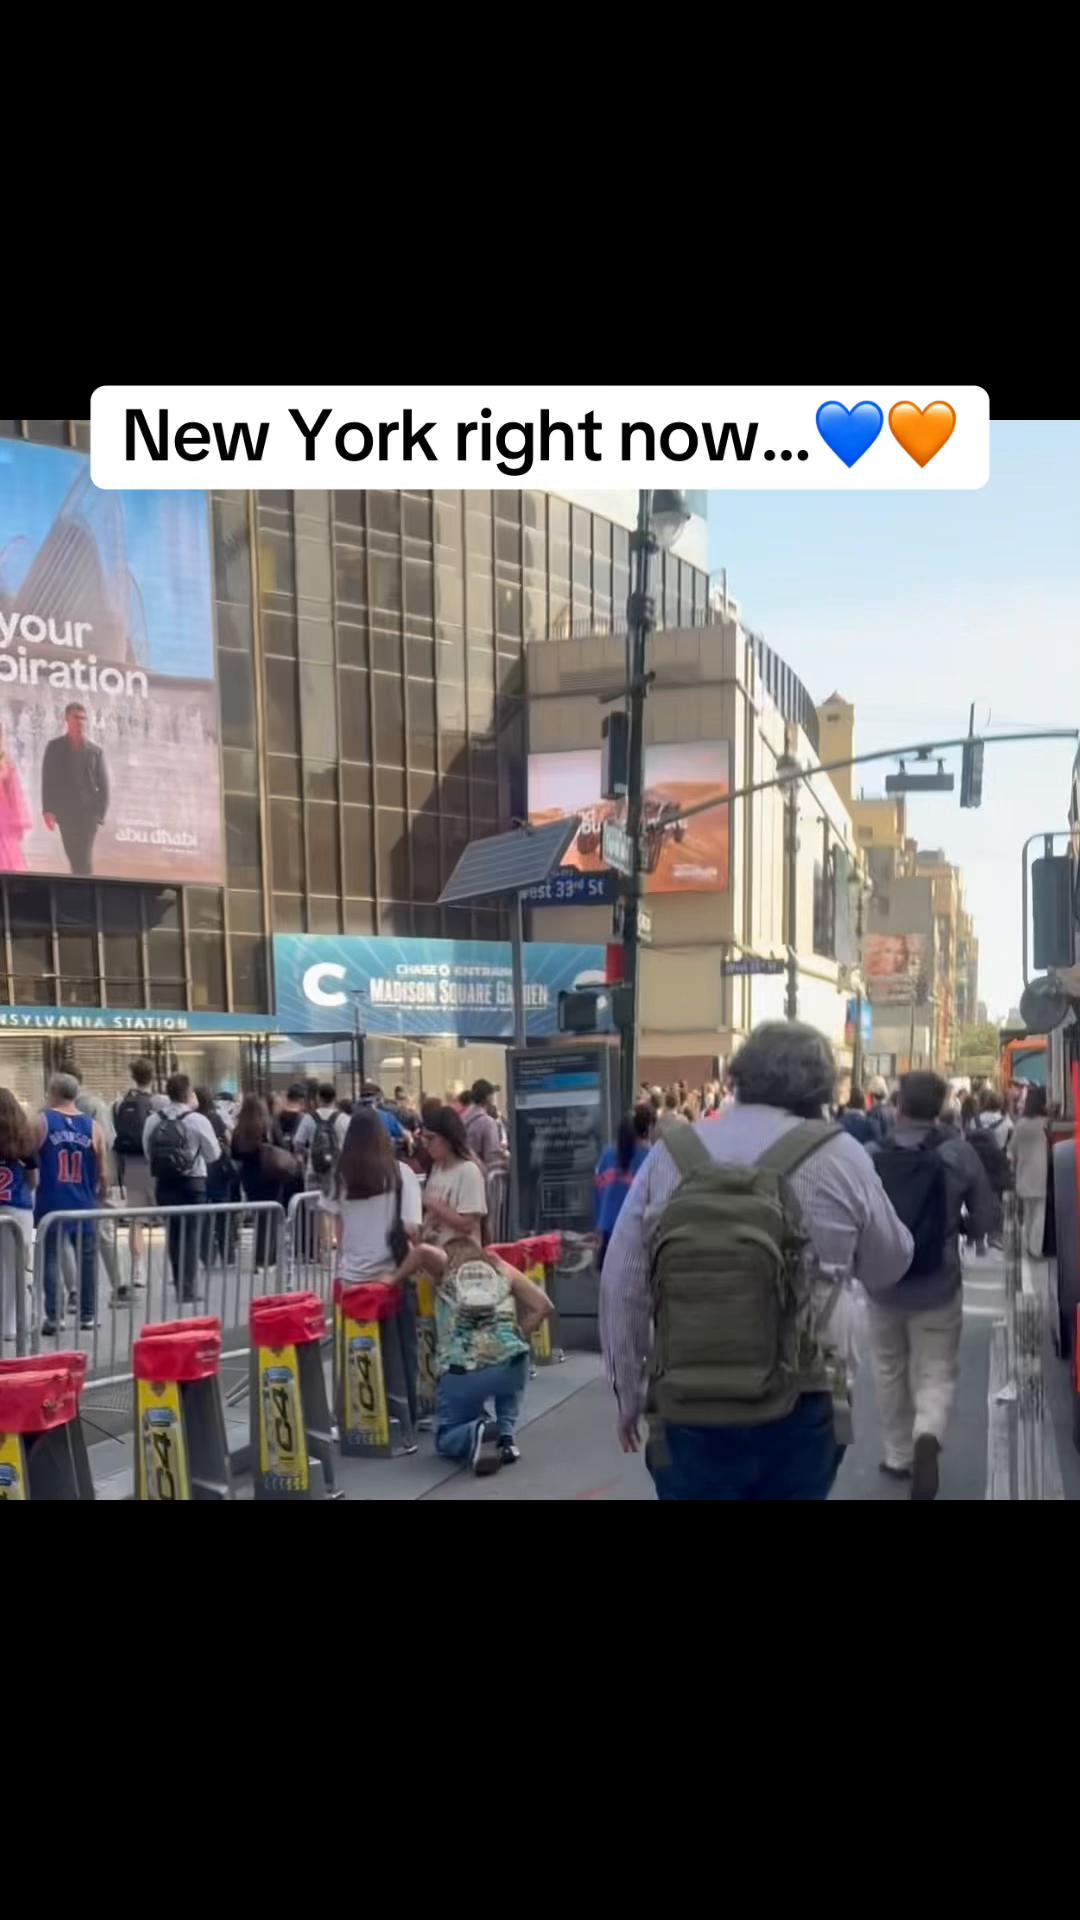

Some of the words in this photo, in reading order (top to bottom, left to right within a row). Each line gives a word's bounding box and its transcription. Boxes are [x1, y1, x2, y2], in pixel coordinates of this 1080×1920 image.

[0, 611, 93, 648] your
[150, 829, 198, 847] dhabi
[588, 879, 604, 895] St
[302, 962, 349, 1007] C
[396, 964, 439, 976] CHASE
[370, 978, 437, 1003] MADISON
[439, 978, 493, 1005] SQUARE
[496, 981, 549, 1005] GADEN
[113, 1016, 188, 1029] STATION
[57, 1149, 83, 1184] 11
[357, 1352, 375, 1412] C4
[272, 1387, 293, 1452] C4
[152, 1431, 176, 1500] C4
